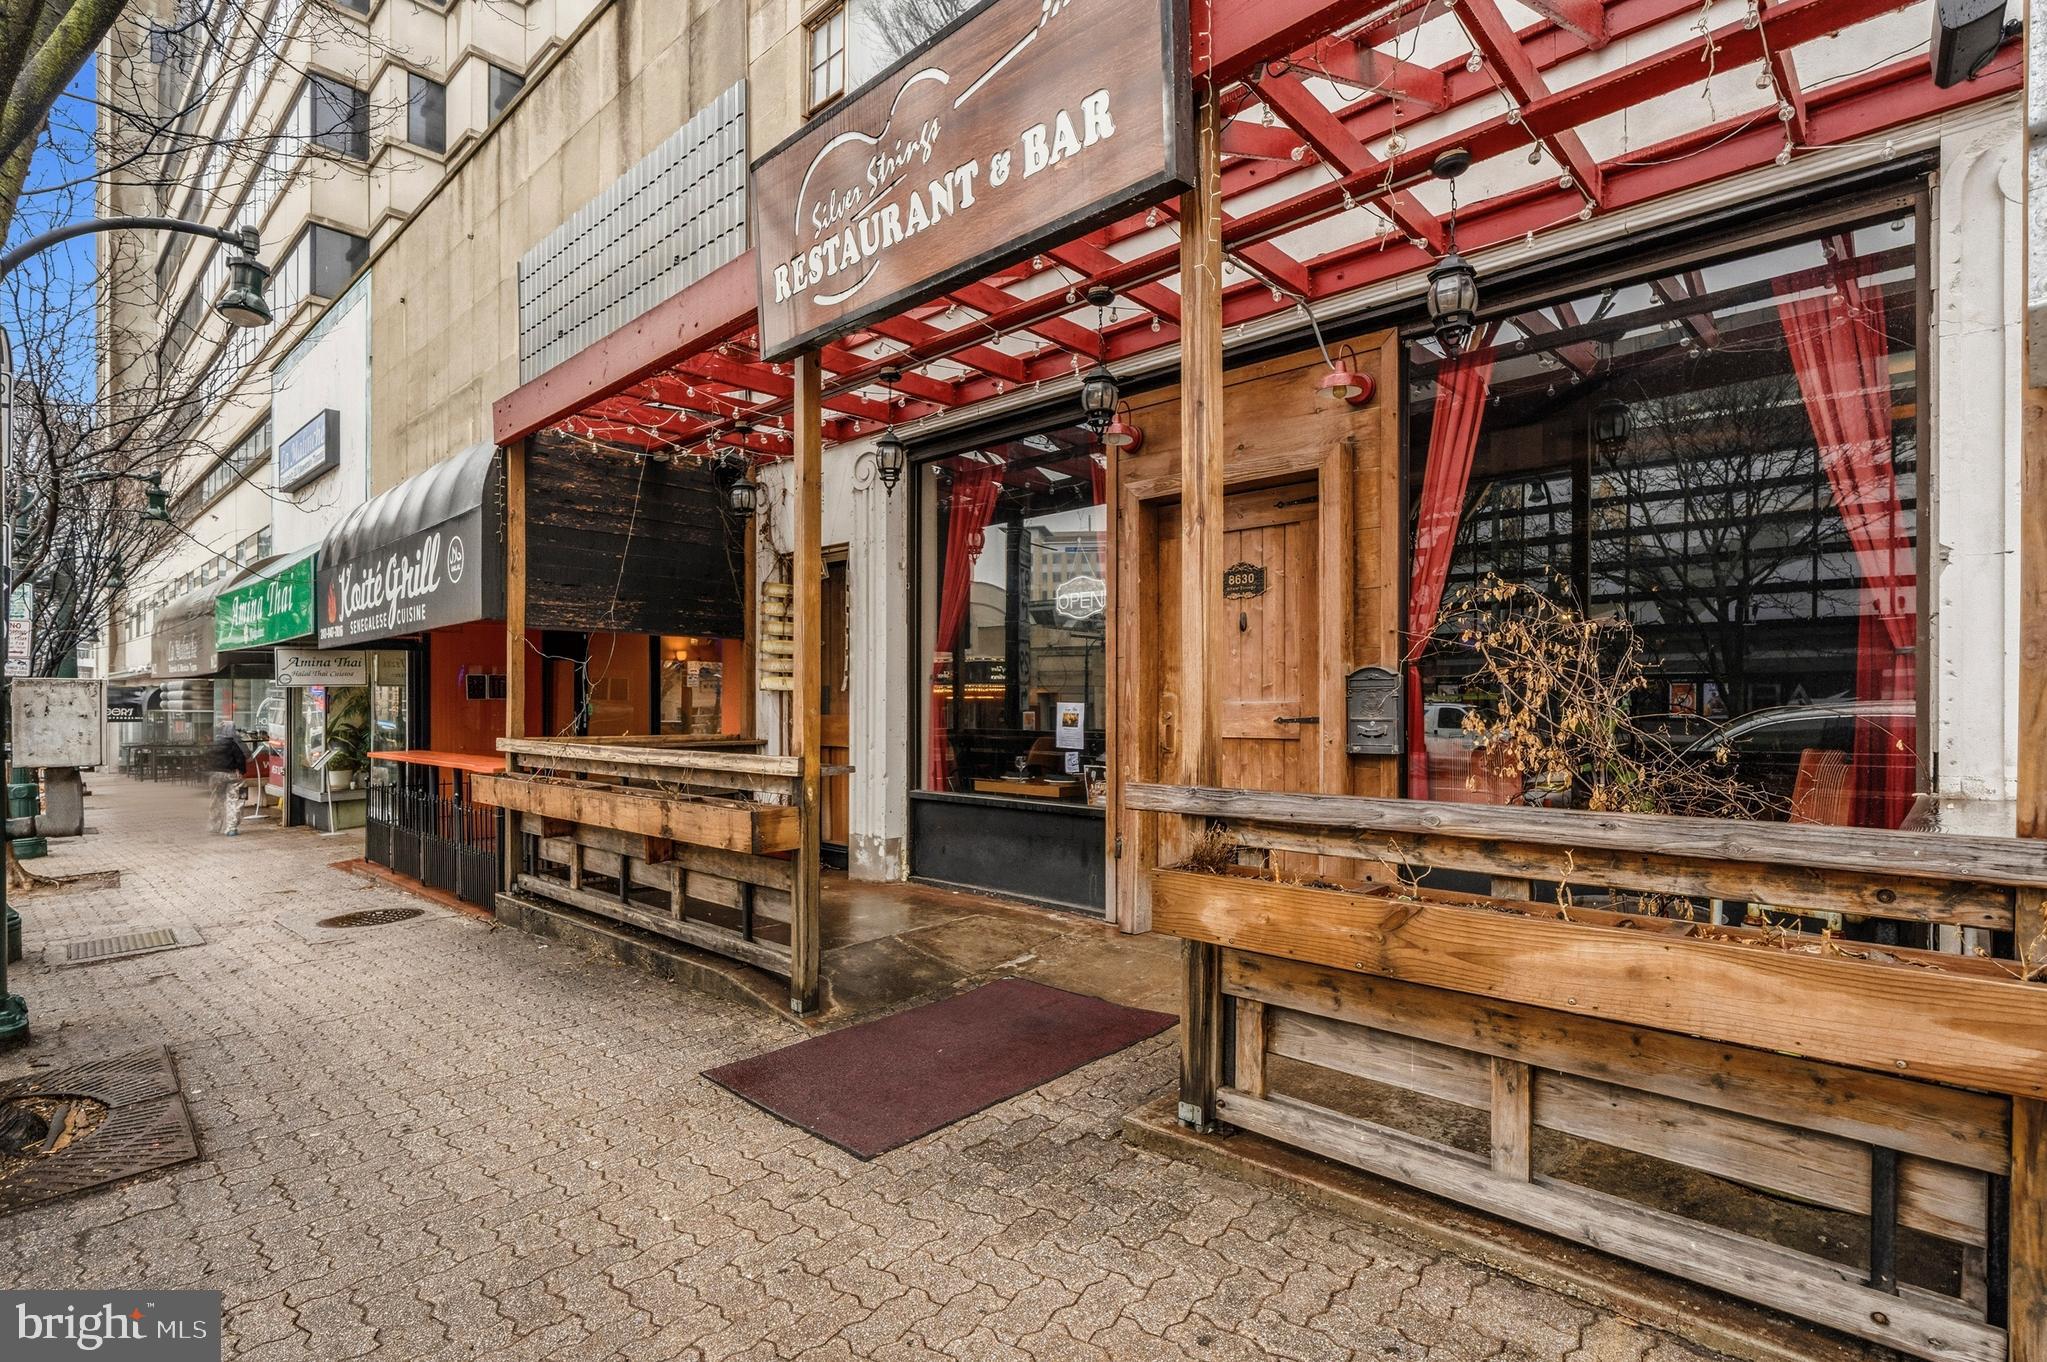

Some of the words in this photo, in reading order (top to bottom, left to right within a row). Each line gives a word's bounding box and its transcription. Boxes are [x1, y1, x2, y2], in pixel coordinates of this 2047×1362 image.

[811, 178, 863, 239] Silver
[866, 117, 942, 201] Strings
[772, 157, 980, 304] RESTAURANT
[989, 147, 1013, 189] &
[1020, 87, 1117, 180] BAR
[338, 560, 385, 624] Koité
[384, 531, 442, 631] Grill
[1228, 573, 1255, 585] 8630
[229, 589, 263, 626] Amina
[266, 573, 294, 617] Thai
[1059, 591, 1104, 610] OPEN
[9, 622, 21, 630] NO
[349, 613, 388, 635] SENEGALESE
[396, 603, 427, 625] CUISINE
[282, 656, 331, 670] Amina
[334, 656, 363, 668] Thai
